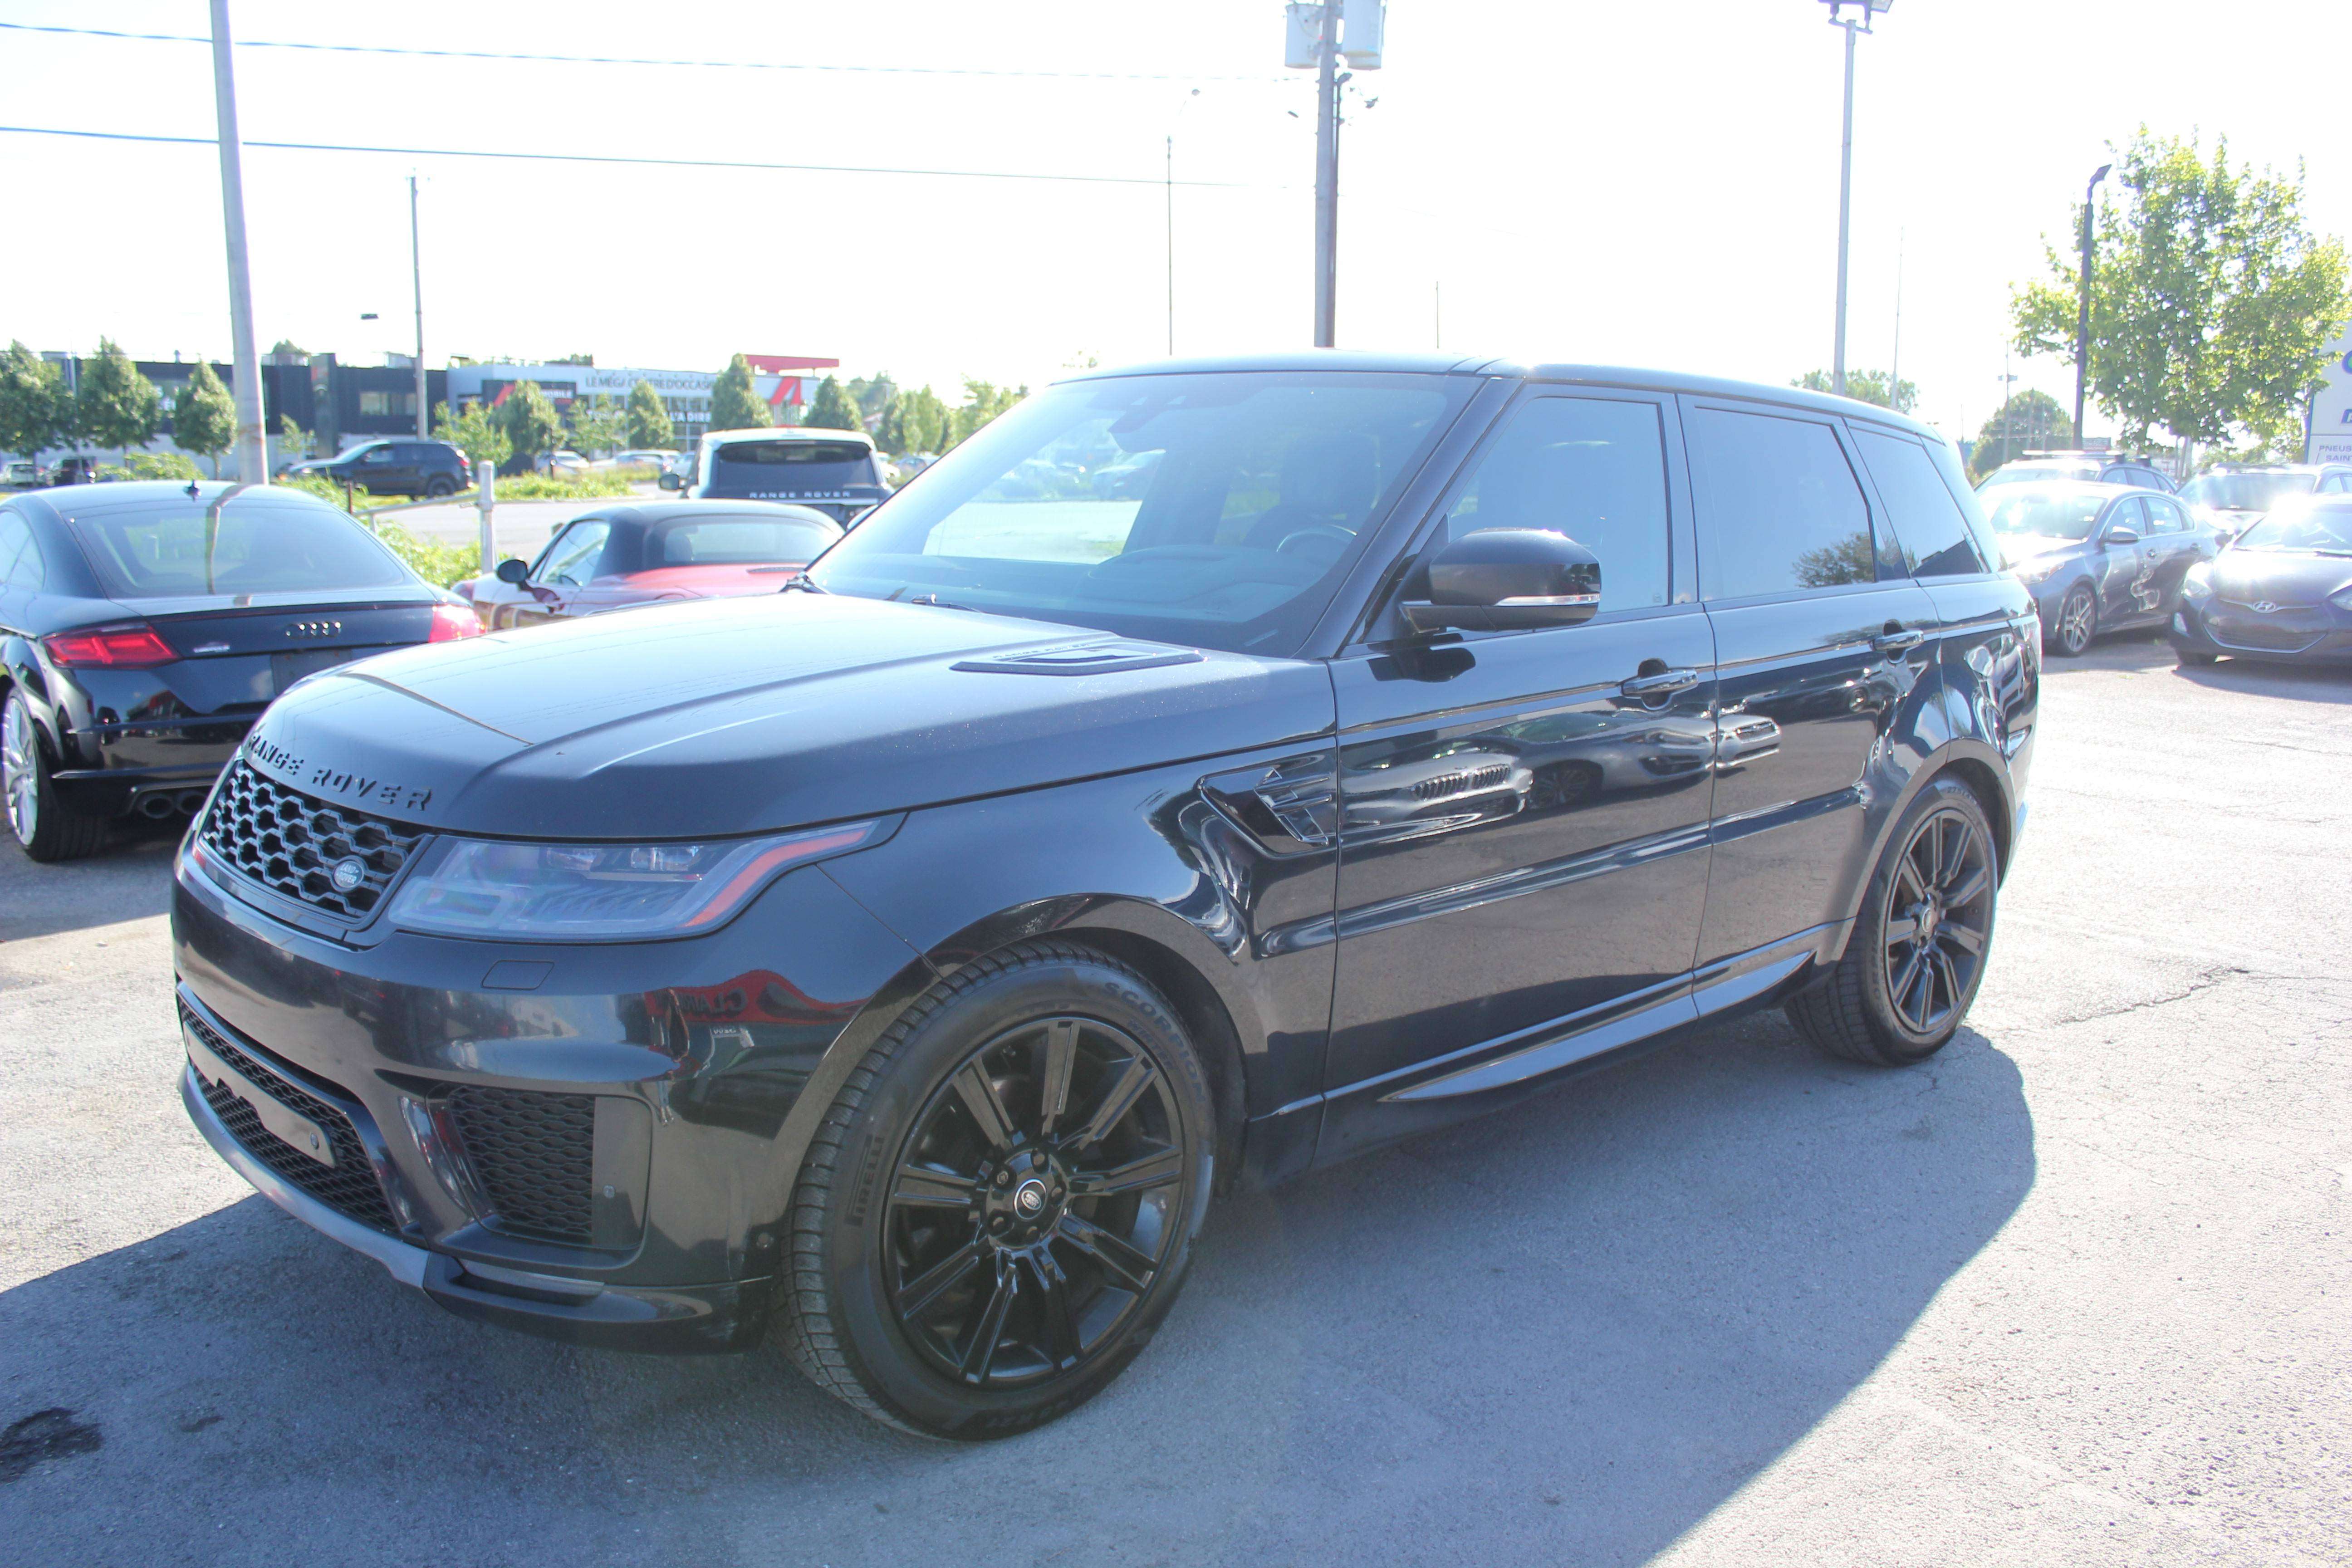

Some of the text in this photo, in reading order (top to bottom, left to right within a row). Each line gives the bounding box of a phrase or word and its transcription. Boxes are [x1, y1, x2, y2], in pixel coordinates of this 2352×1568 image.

[586, 377, 597, 387] LE
[248, 734, 432, 811] RANGE ROVER
[1104, 981, 1206, 1104] SCORPION
[844, 1134, 884, 1227] PIRELLI
